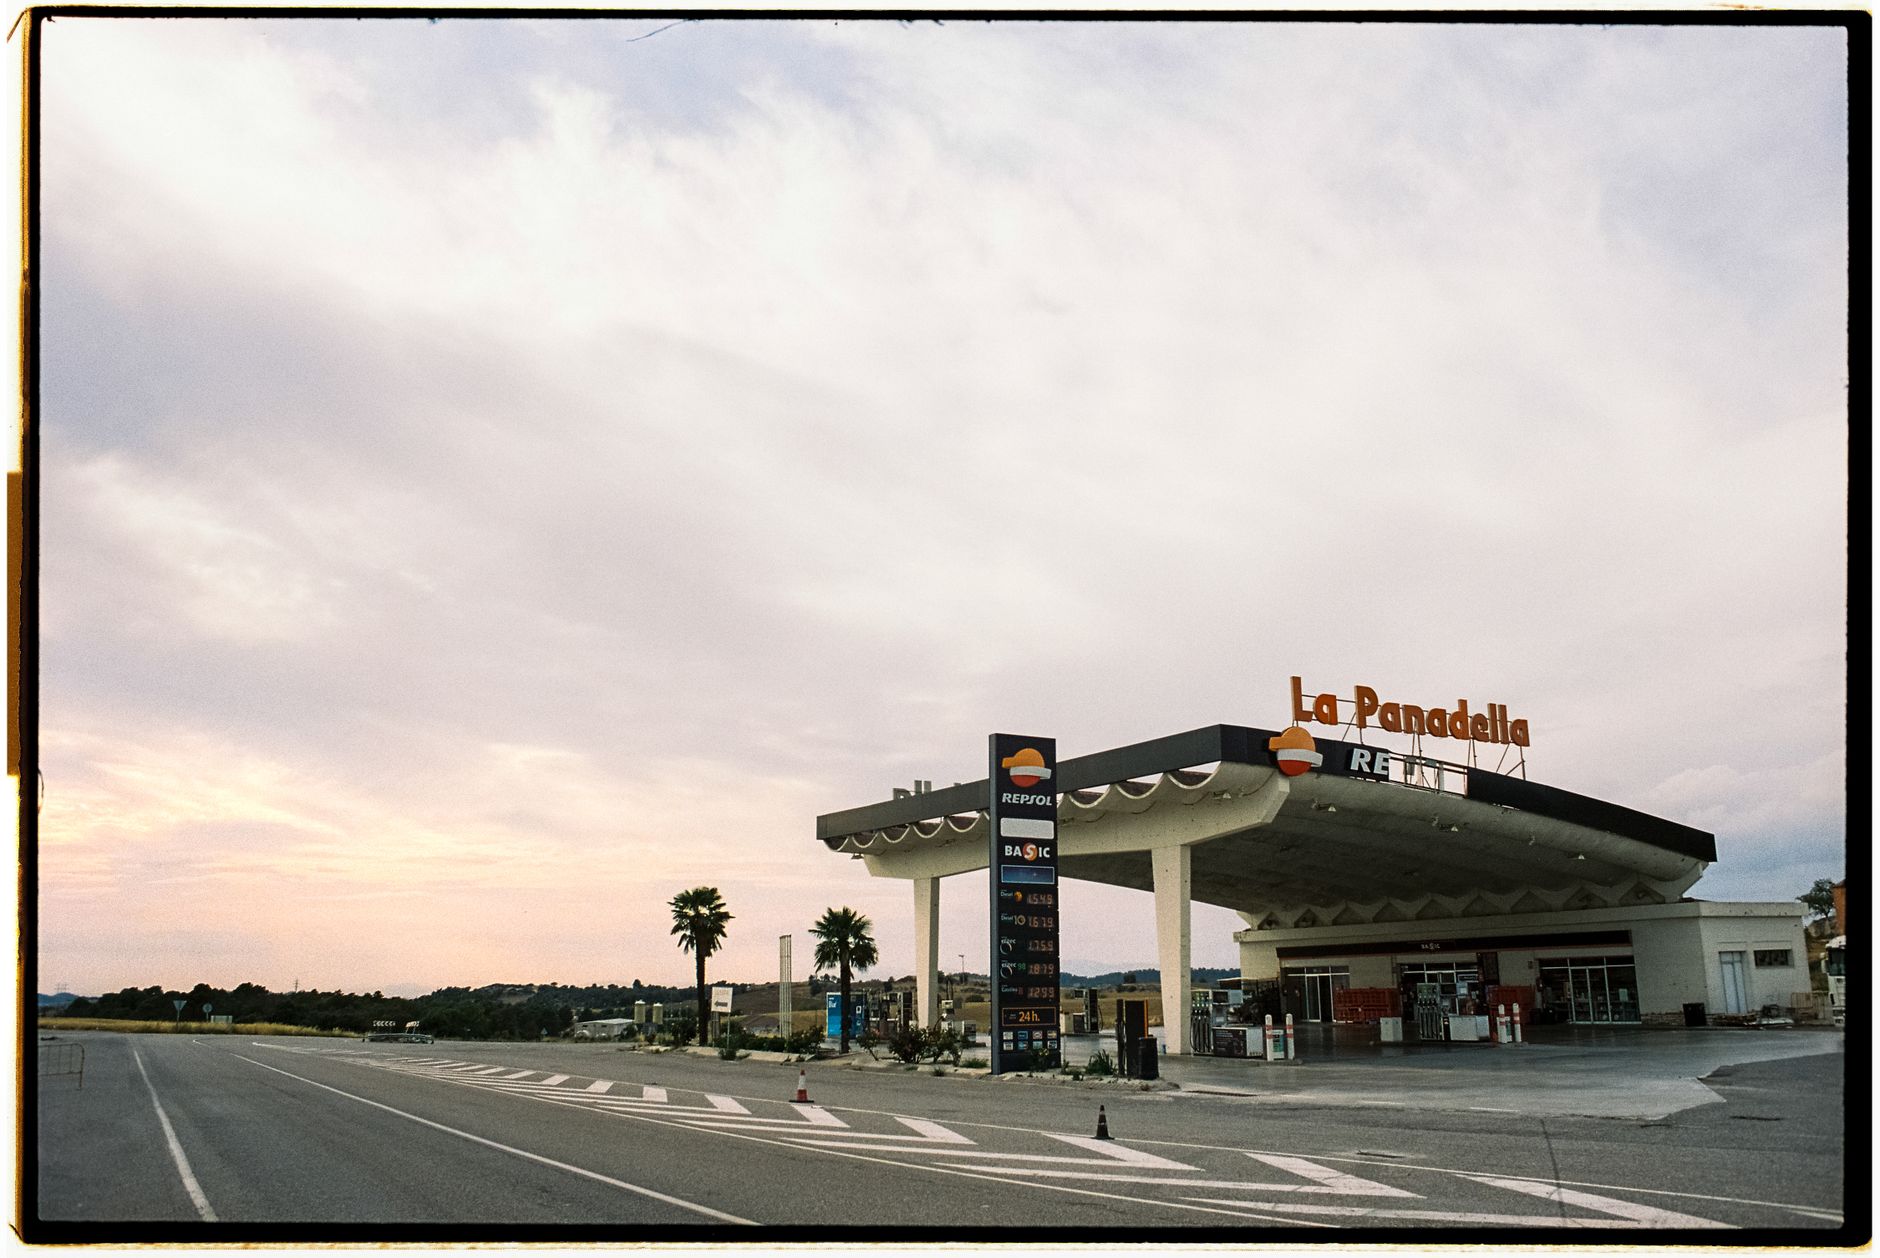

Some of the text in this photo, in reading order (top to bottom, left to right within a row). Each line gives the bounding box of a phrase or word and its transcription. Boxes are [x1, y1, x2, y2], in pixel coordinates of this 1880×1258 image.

[1290, 676, 1530, 747] La Panadella
[1350, 748, 1390, 776] RE
[1002, 793, 1052, 806] REPSOL
[1004, 843, 1051, 862] BASIC
